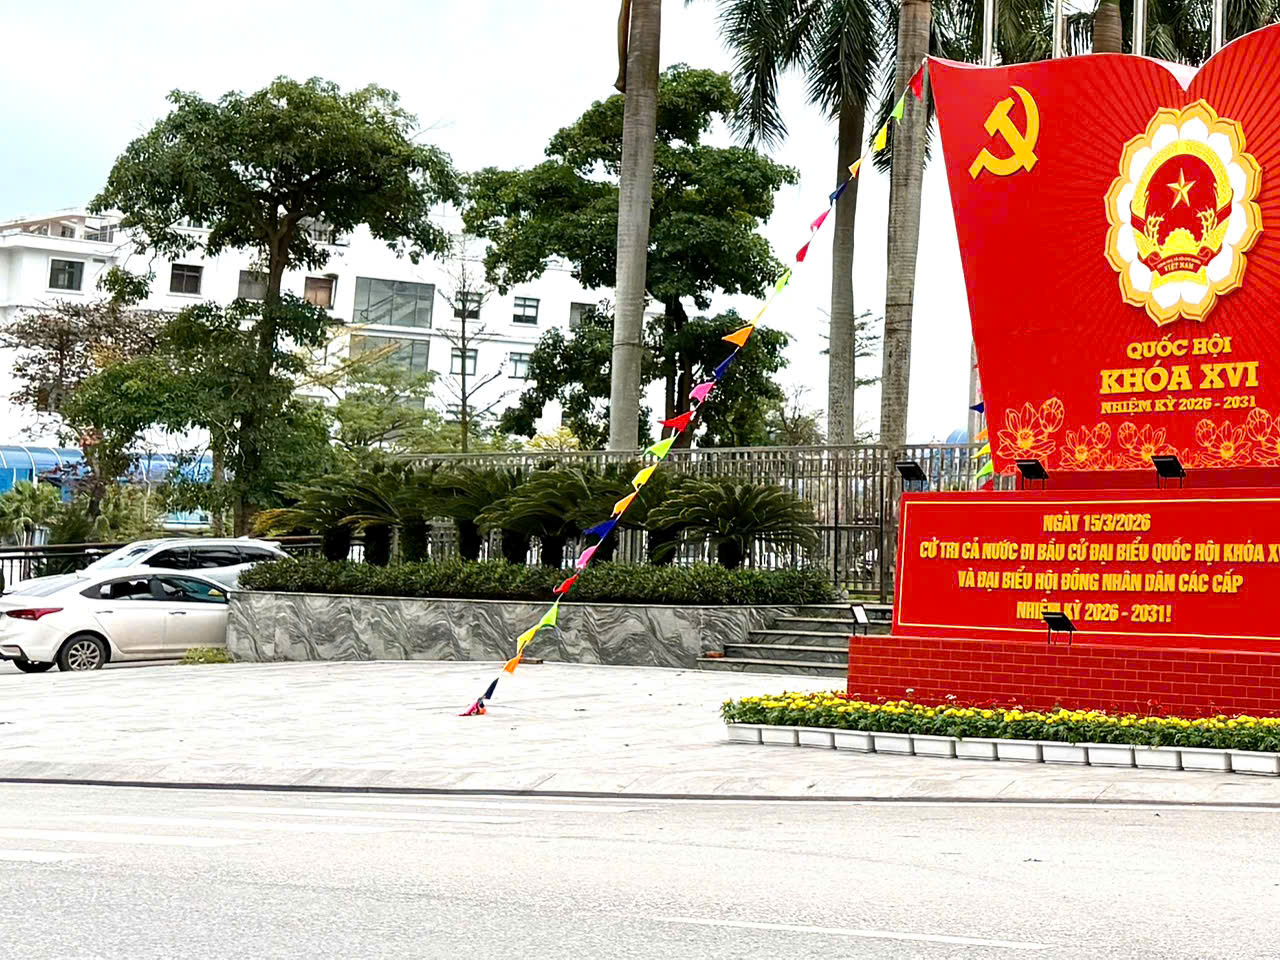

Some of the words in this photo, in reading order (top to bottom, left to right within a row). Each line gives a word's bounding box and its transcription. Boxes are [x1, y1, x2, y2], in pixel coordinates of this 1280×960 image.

[1126, 333, 1189, 360] QUỐC
[1192, 333, 1232, 357] HỘI
[1100, 360, 1192, 394] KHÓA
[1200, 361, 1259, 389] XVI
[1101, 397, 1152, 416] NHIỆM
[1154, 395, 1177, 412] KỲ
[1178, 397, 1212, 411] 2026
[1224, 396, 1256, 409] 2031
[1043, 510, 1080, 532] NGÀY
[1083, 514, 1151, 532] 15/3/2026
[920, 536, 940, 558] CỬ
[940, 542, 960, 559] TRI
[962, 537, 980, 559] CẢ
[982, 539, 1018, 560] NƯỚC
[1020, 544, 1035, 560] ĐI
[1037, 538, 1064, 560] BẦU
[1067, 538, 1088, 560] CỬ
[1089, 544, 1113, 565] ĐẠI
[1116, 536, 1149, 561] BIỂU
[1152, 537, 1191, 563] QUỐC
[1195, 540, 1220, 566] HỘI
[1224, 540, 1264, 562] KHÓA
[958, 567, 975, 588] VÀ
[977, 570, 1000, 592] ĐẠI
[1002, 565, 1032, 590] BIỂU
[1035, 570, 1058, 594] HỘI
[1061, 568, 1099, 591] ĐỒNG
[1102, 570, 1142, 592] NHÂN
[1145, 570, 1176, 592] DÂN
[1178, 570, 1209, 593] CÁC
[1212, 568, 1244, 593] CẤP
[1063, 600, 1082, 621] KỲ
[1084, 604, 1118, 621] 2026
[1131, 604, 1172, 622] 2031!
